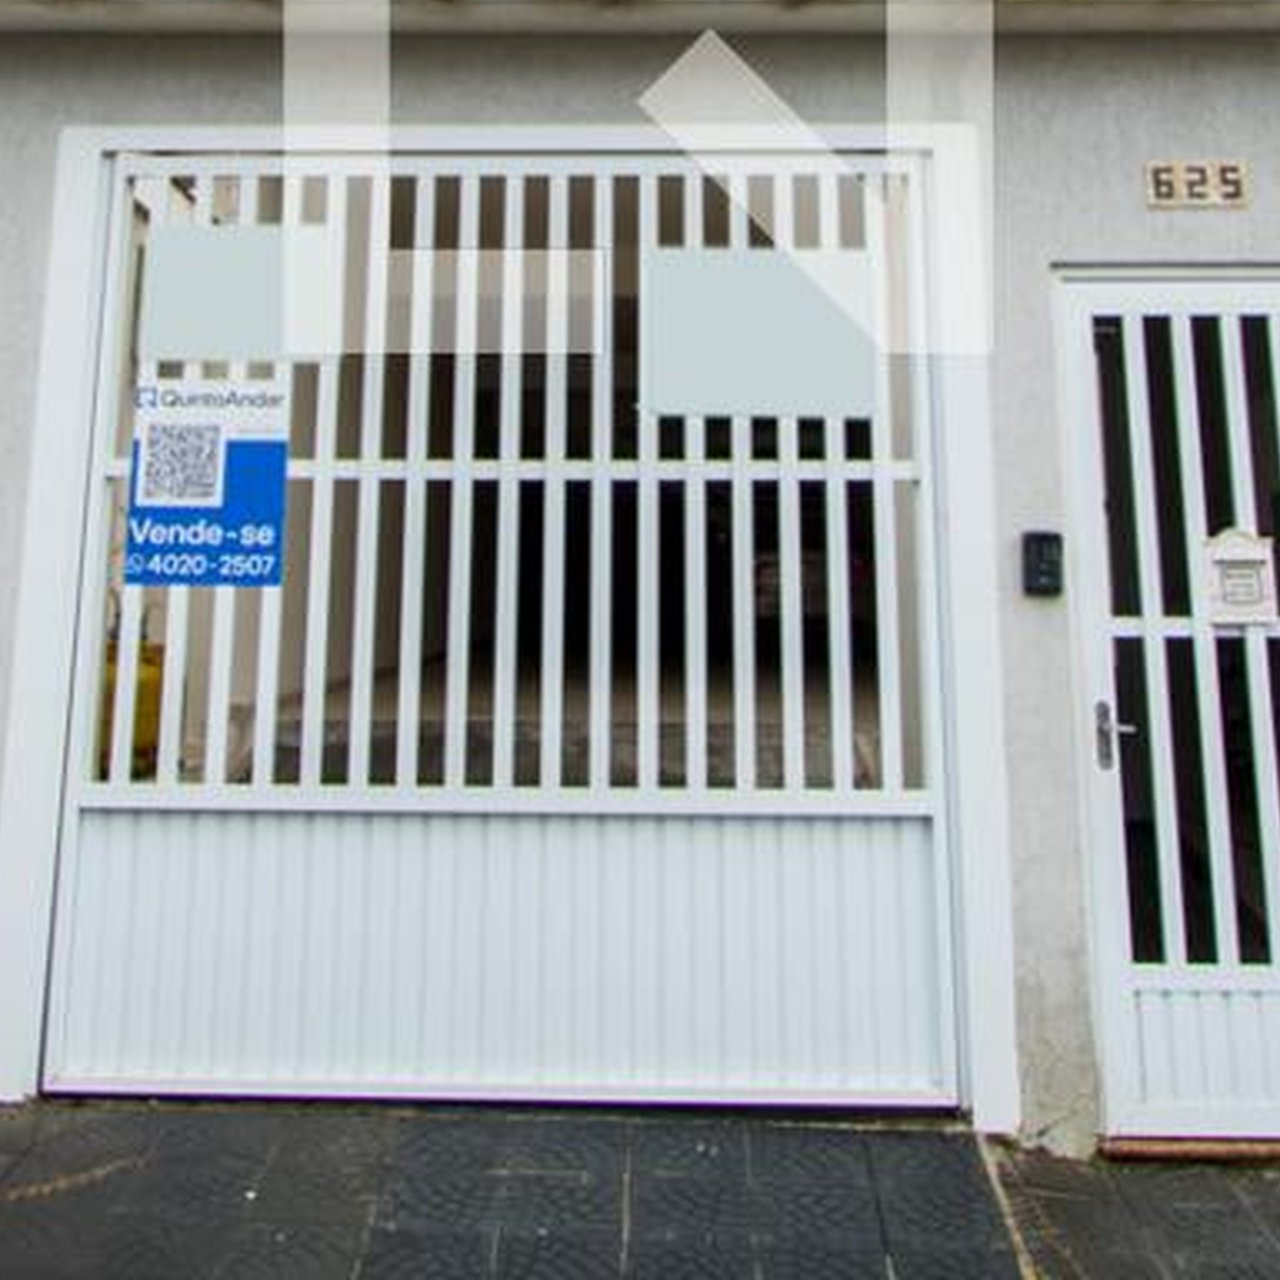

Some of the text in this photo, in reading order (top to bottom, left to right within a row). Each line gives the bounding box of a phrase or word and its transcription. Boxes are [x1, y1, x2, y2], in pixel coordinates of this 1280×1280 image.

[1151, 165, 1243, 199] 625
[160, 389, 284, 408] QuintoAndar
[130, 518, 275, 546] Vende-se
[148, 553, 275, 576] 4020-2507
